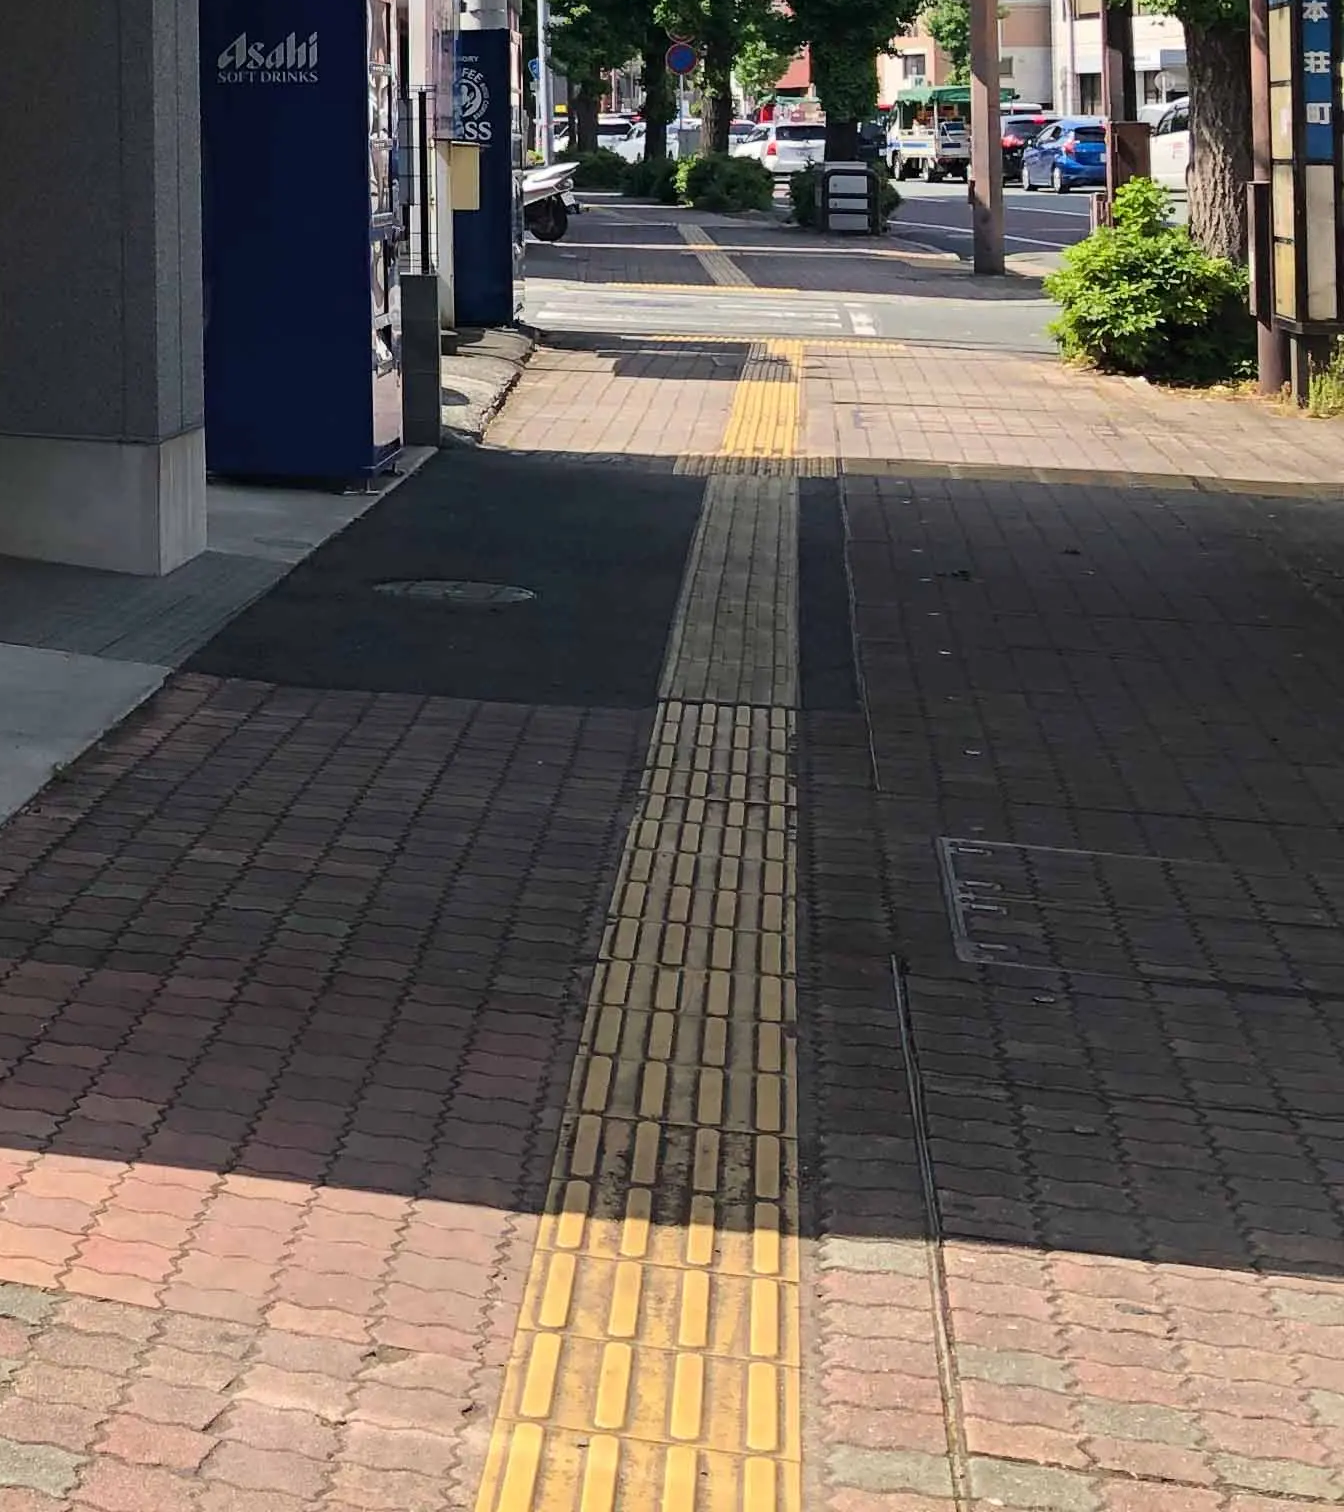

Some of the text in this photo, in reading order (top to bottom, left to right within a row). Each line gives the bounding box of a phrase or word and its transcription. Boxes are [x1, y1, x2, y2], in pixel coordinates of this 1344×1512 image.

[217, 31, 318, 69] Asahi
[1301, 0, 1332, 125] 本荘町
[217, 70, 319, 83] SOFT DRINKS
